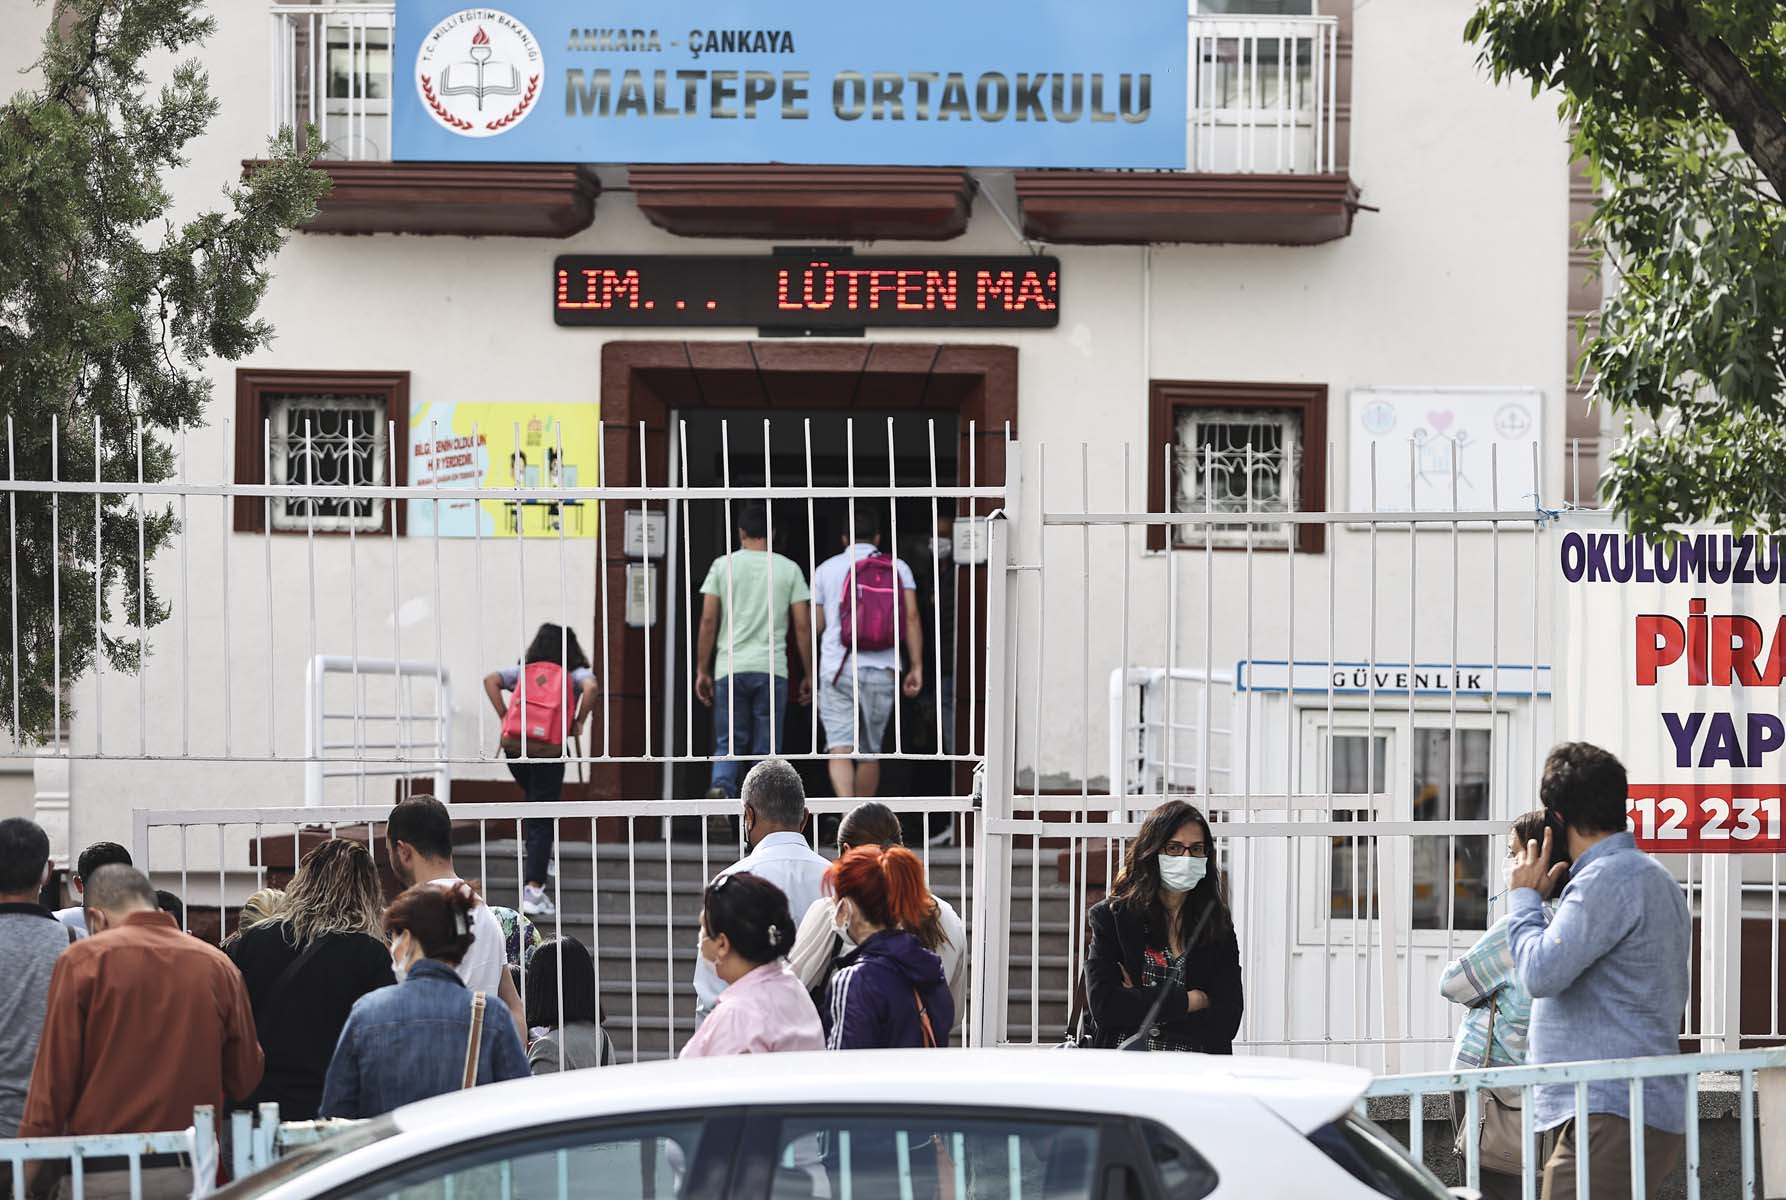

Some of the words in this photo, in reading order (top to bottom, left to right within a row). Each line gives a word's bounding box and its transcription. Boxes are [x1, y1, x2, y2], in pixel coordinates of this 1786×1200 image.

[567, 28, 662, 52] ANKARA
[688, 29, 795, 59] ÇANKAYA
[565, 68, 810, 119] MALTEPE
[832, 69, 1152, 124] ORTAOKULU
[778, 262, 957, 310] LÜTFEN
[1561, 532, 1786, 584] OKULUMUZU
[1333, 668, 1481, 689] GÜVENLİK
[1662, 713, 1785, 768] YAP
[1699, 798, 1781, 840] 231
